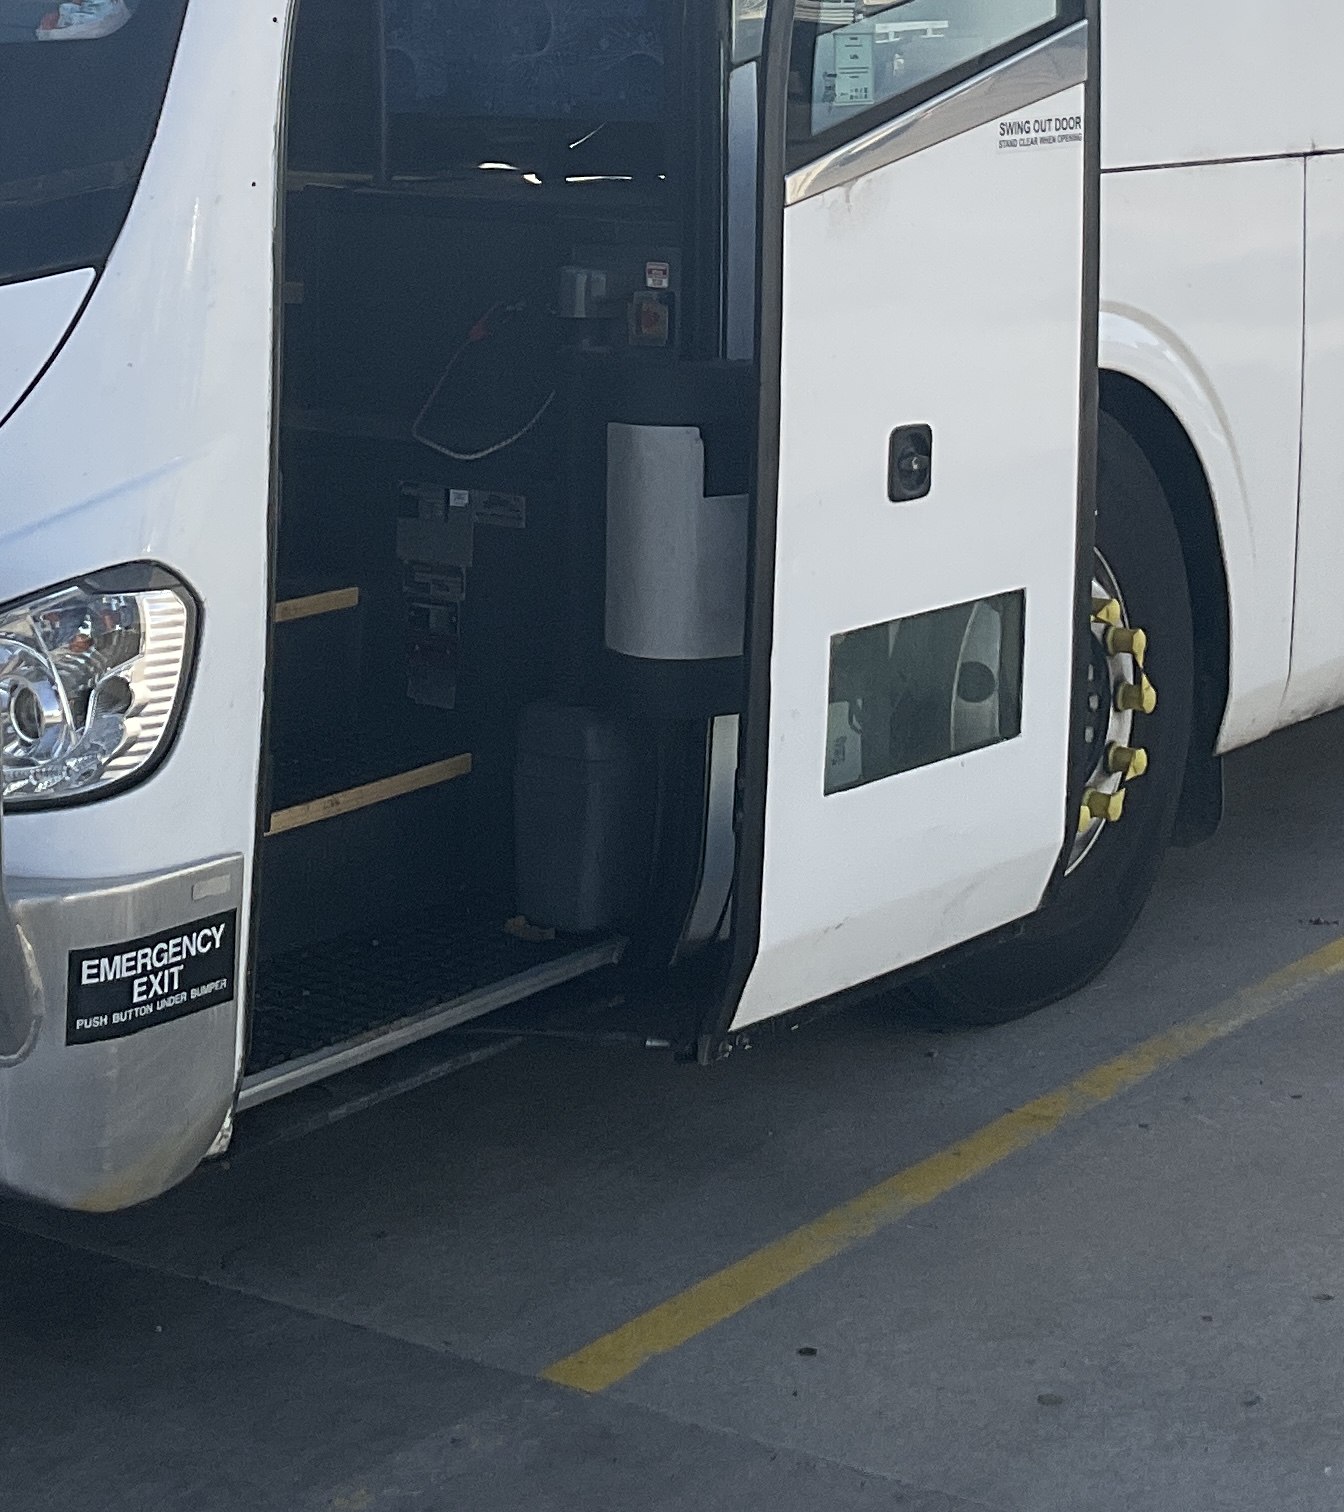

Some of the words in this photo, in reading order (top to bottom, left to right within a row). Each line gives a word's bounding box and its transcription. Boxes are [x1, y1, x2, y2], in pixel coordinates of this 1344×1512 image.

[999, 120, 1031, 137] SWING
[1033, 118, 1053, 133] OUT
[1054, 116, 1082, 132] DOOR
[999, 139, 1018, 149] STAND
[1019, 137, 1038, 147] CLEAR
[1039, 135, 1056, 144] WHEN
[1057, 133, 1083, 143] OPENING
[81, 923, 225, 985] EMERGENCY
[132, 964, 184, 1003] EXIT
[76, 1014, 108, 1030] PUSH
[112, 1004, 154, 1024] BUTTON
[156, 991, 187, 1010] UNDER
[190, 978, 228, 998] BUMPER
